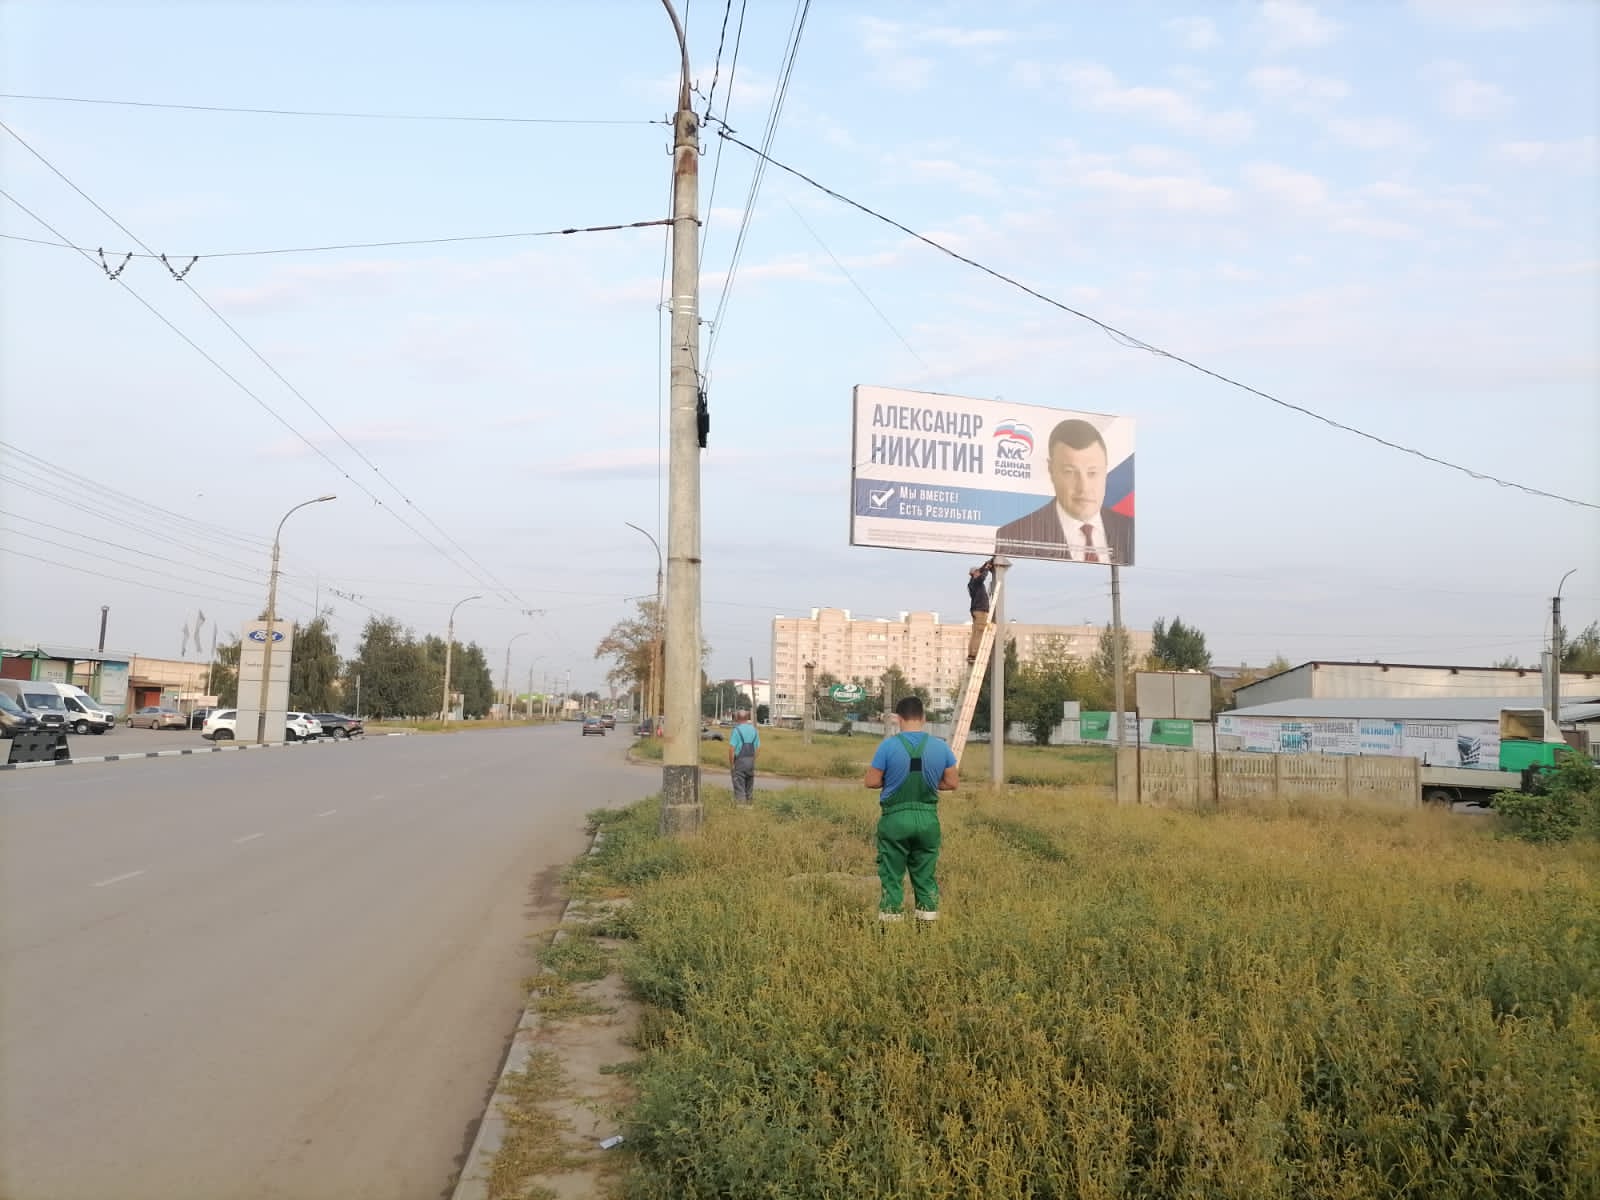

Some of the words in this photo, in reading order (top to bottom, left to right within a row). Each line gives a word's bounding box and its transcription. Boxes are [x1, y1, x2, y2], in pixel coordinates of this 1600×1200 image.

[872, 403, 983, 439] АЛЕКСАНДР
[871, 433, 984, 474] НИКИТИН
[994, 460, 1031, 471] ЕДИНАЯ
[994, 468, 1031, 479] РОССИЯ
